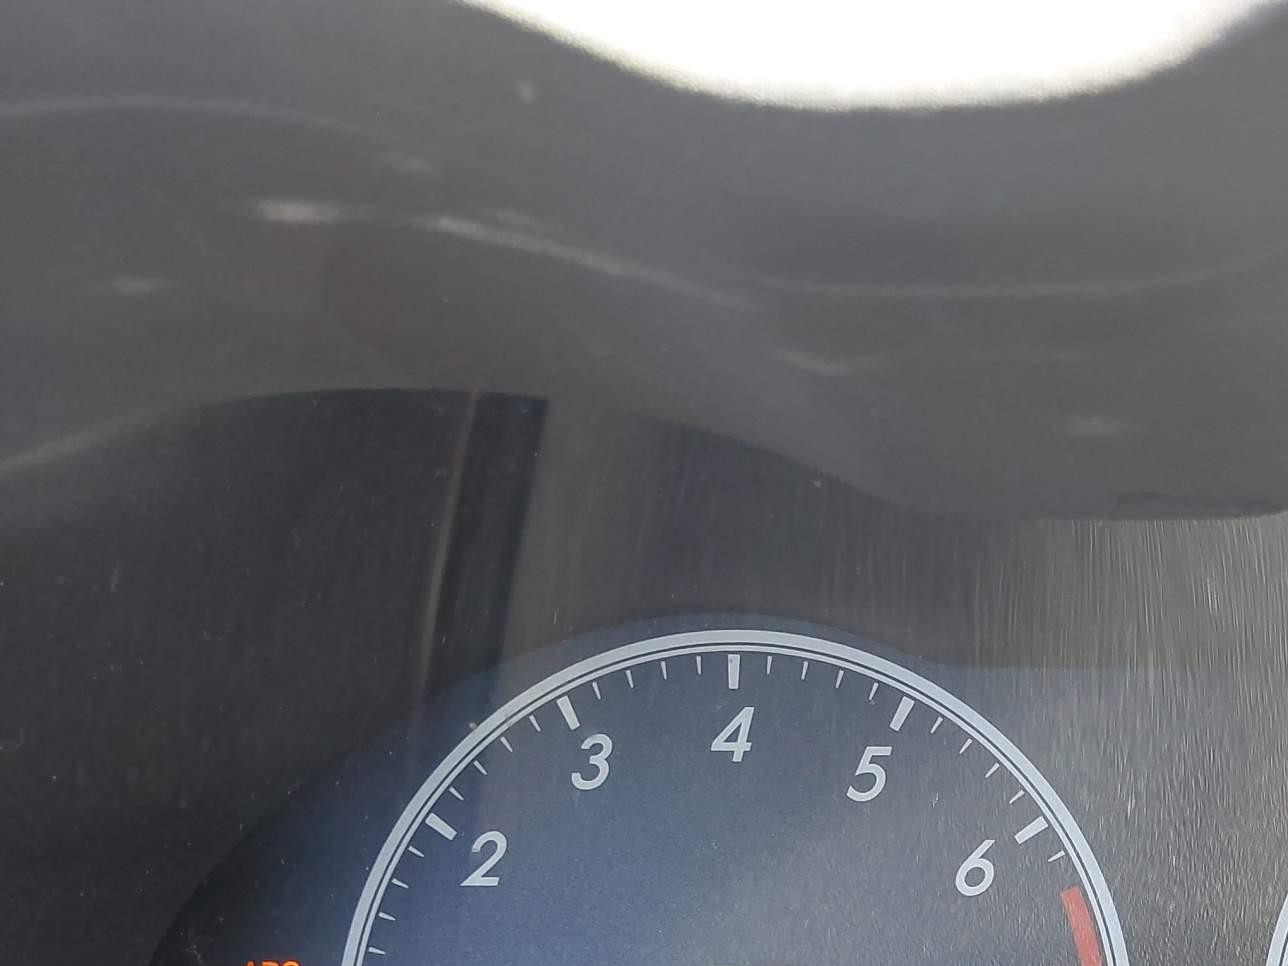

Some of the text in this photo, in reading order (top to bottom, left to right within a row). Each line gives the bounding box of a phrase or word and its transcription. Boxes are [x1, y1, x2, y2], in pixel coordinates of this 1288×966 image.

[570, 734, 613, 790] 3
[710, 707, 755, 762] 4
[846, 746, 892, 802] 5
[460, 831, 508, 886] 2
[955, 840, 995, 895] 6
